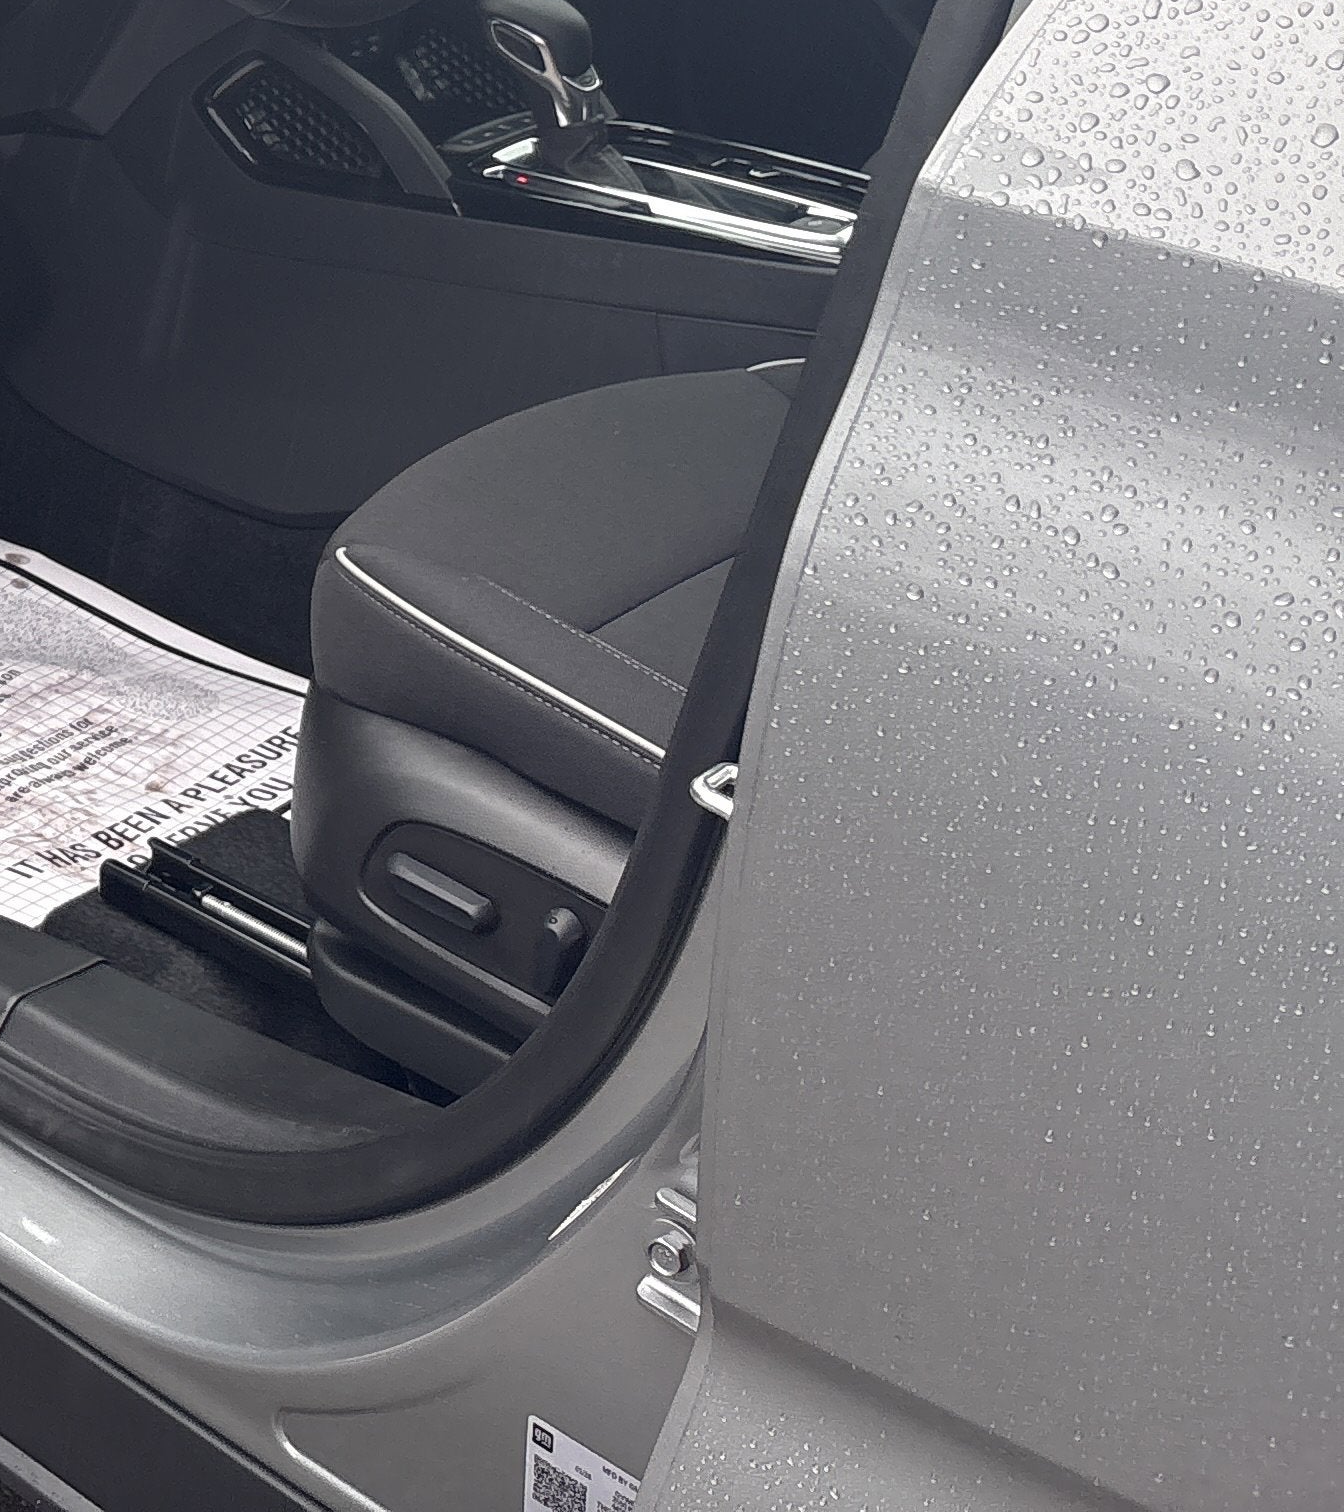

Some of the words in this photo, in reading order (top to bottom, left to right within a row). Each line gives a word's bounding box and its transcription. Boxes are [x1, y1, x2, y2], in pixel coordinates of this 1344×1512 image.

[68, 717, 95, 732] for
[46, 748, 73, 766] our
[227, 776, 294, 809] YOU
[4, 857, 44, 880] IT
[34, 842, 102, 870] HAS
[91, 805, 172, 851] BEEN
[160, 797, 194, 815] A
